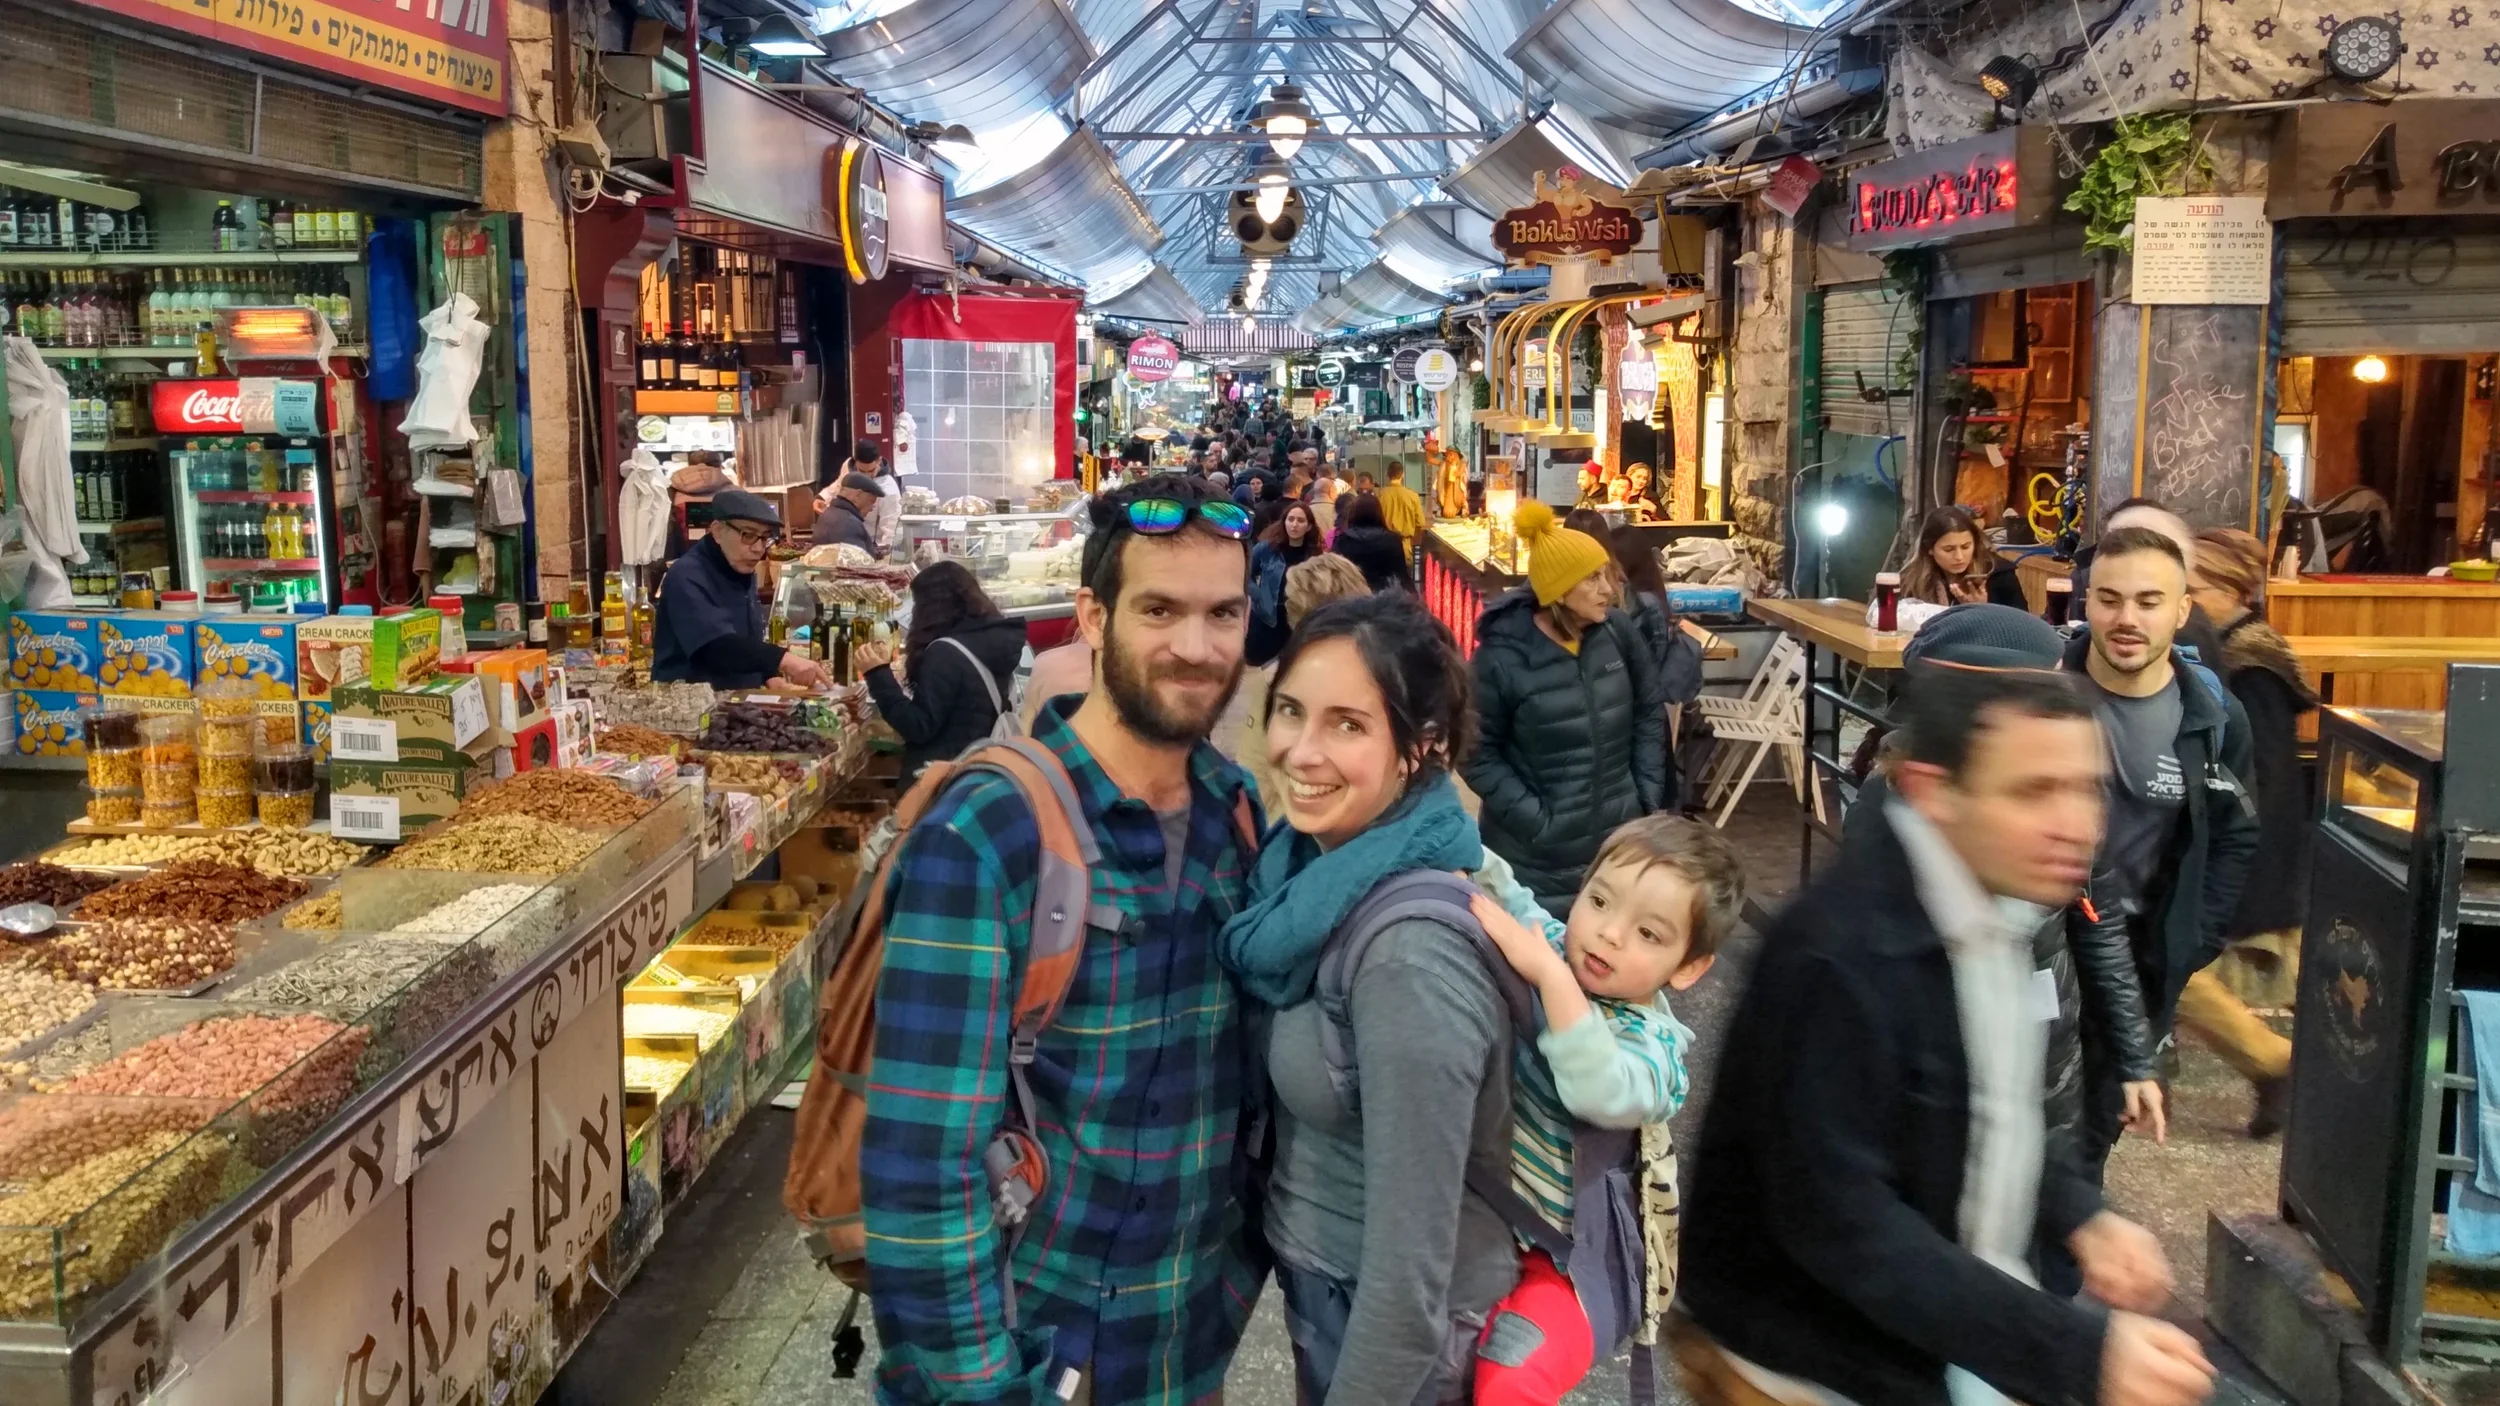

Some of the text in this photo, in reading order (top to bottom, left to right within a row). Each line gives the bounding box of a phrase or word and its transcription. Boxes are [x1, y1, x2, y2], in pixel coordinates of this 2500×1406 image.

[327, 17, 409, 67] ממתקים
[427, 49, 494, 92] פיצוחים
[1850, 183, 1868, 235] A
[1956, 165, 2002, 217] BAR
[2186, 204, 2224, 214] הודעה
[2143, 220, 2158, 228] של
[2228, 232, 2265, 240] משקאות
[1131, 355, 1174, 370] RIMON
[298, 628, 374, 639] CREAM CRACKE
[204, 639, 271, 666] Cracker
[142, 699, 197, 710] CRACKERS
[256, 702, 295, 714] ACKERS
[381, 696, 448, 714] NATURE VALLEY
[384, 773, 453, 790] NATURE VALLEY
[2156, 772, 2183, 785] מסע
[2146, 779, 2187, 795] שראלי
[569, 887, 668, 1009] פיצוחי
